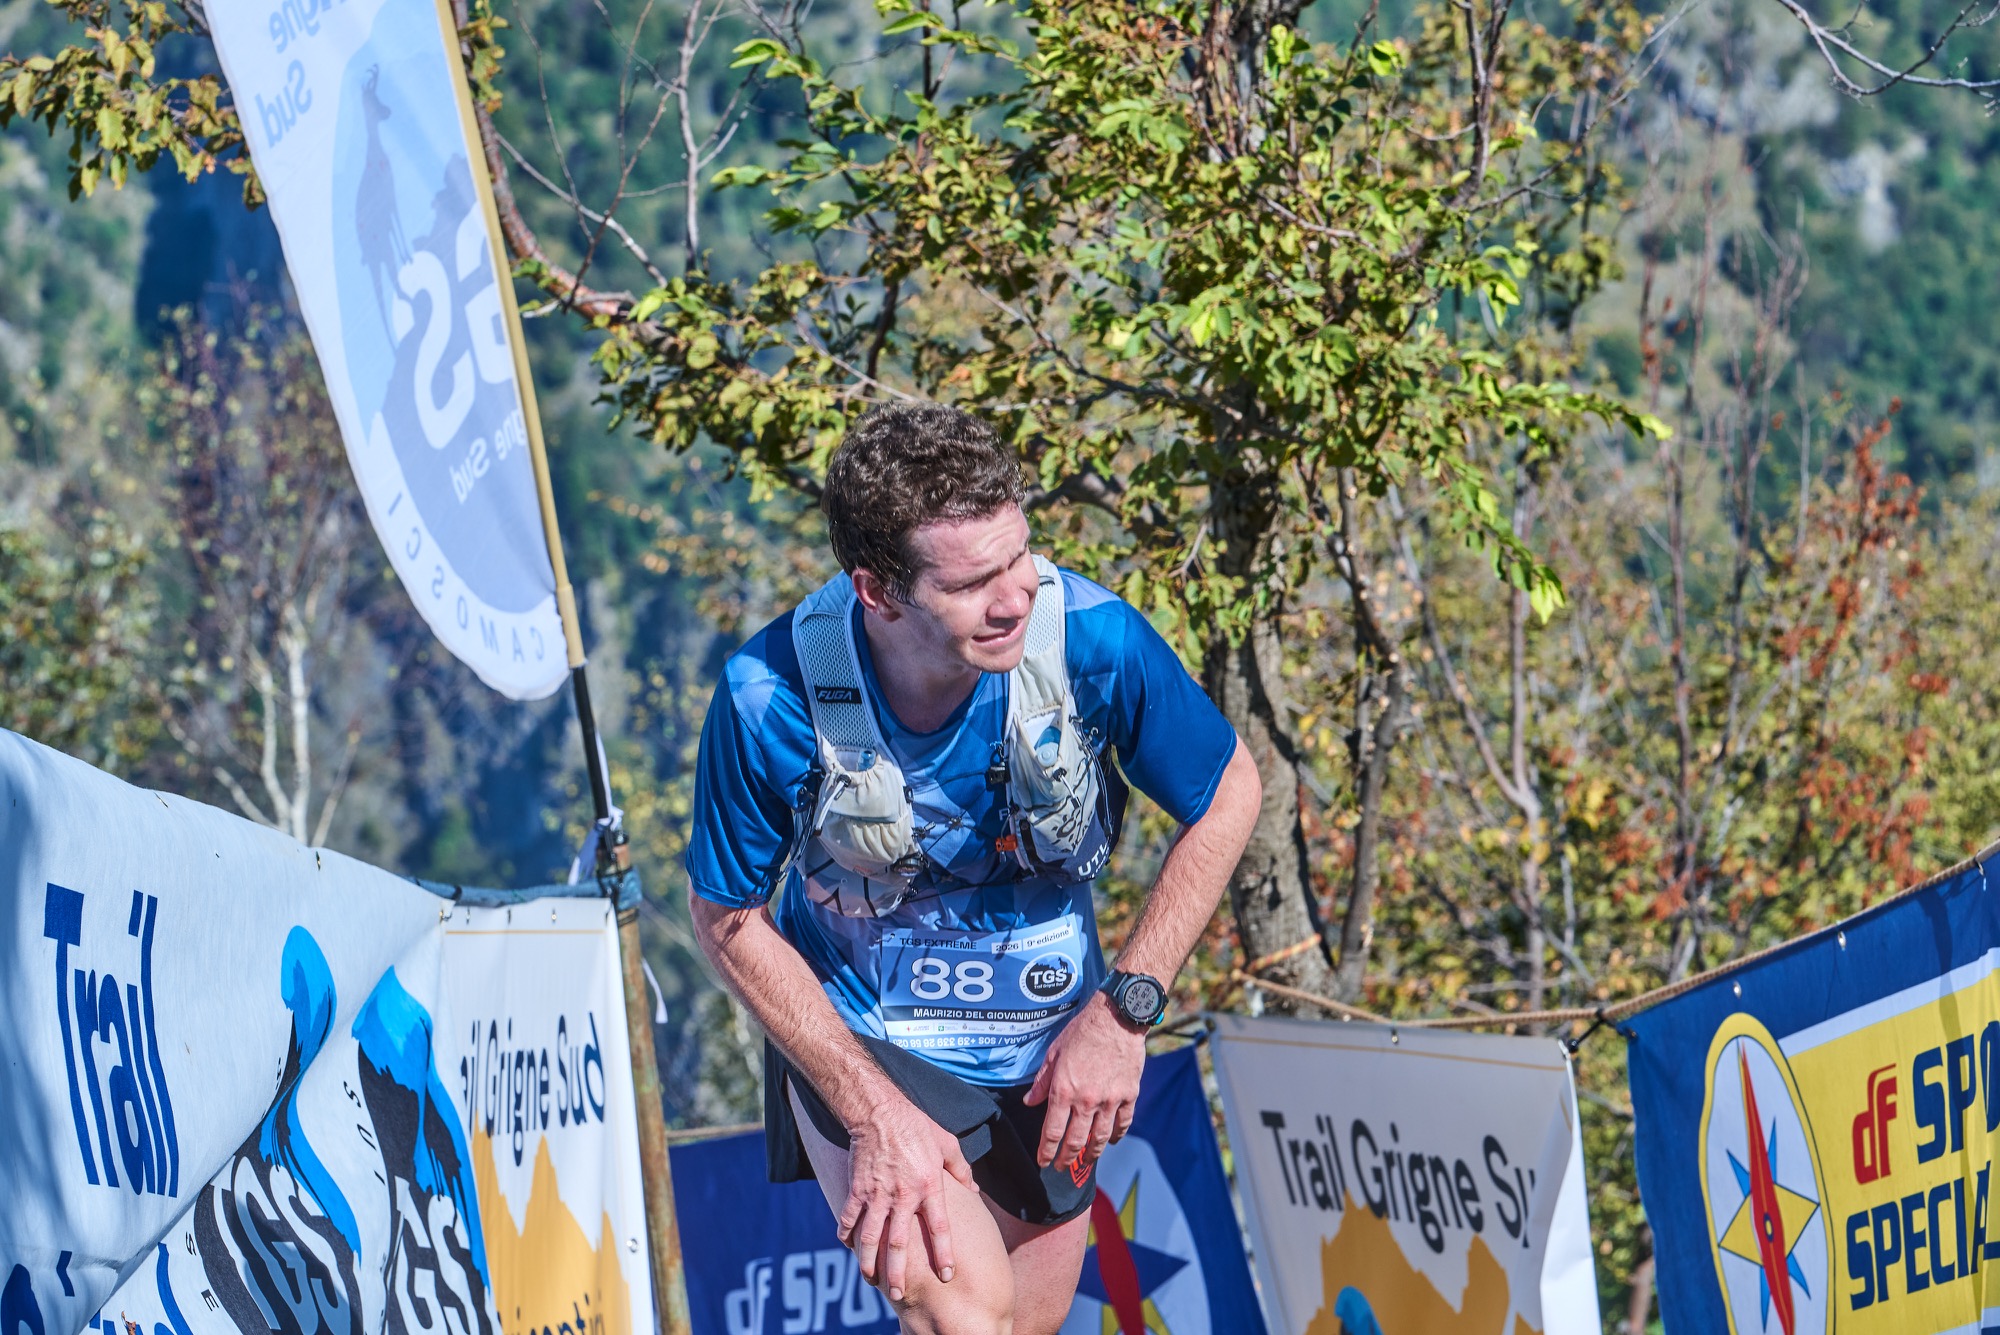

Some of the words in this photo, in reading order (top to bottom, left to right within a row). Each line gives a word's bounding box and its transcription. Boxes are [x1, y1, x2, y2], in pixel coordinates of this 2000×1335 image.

[817, 690, 852, 701] FUGA
[900, 937, 921, 947] TGS
[924, 939, 977, 950] EXTREME
[1036, 929, 1070, 945] edizione
[995, 943, 1019, 952] 2026
[909, 957, 995, 1003] 88
[1030, 967, 1067, 986] TGS
[913, 1008, 963, 1018] MAURIZIO
[965, 1010, 985, 1019] DEL
[986, 1009, 1048, 1020] GIOVANNINO
[44, 882, 179, 1199] Trail
[937, 1036, 956, 1047] 339
[958, 1036, 975, 1046] +39
[978, 1036, 996, 1045] SOS
[485, 1016, 550, 1168] Grigne
[557, 1011, 606, 1129] Sud
[1259, 1110, 1345, 1213] Trail
[1350, 1117, 1484, 1255] Grigne
[782, 1248, 898, 1335] SPO
